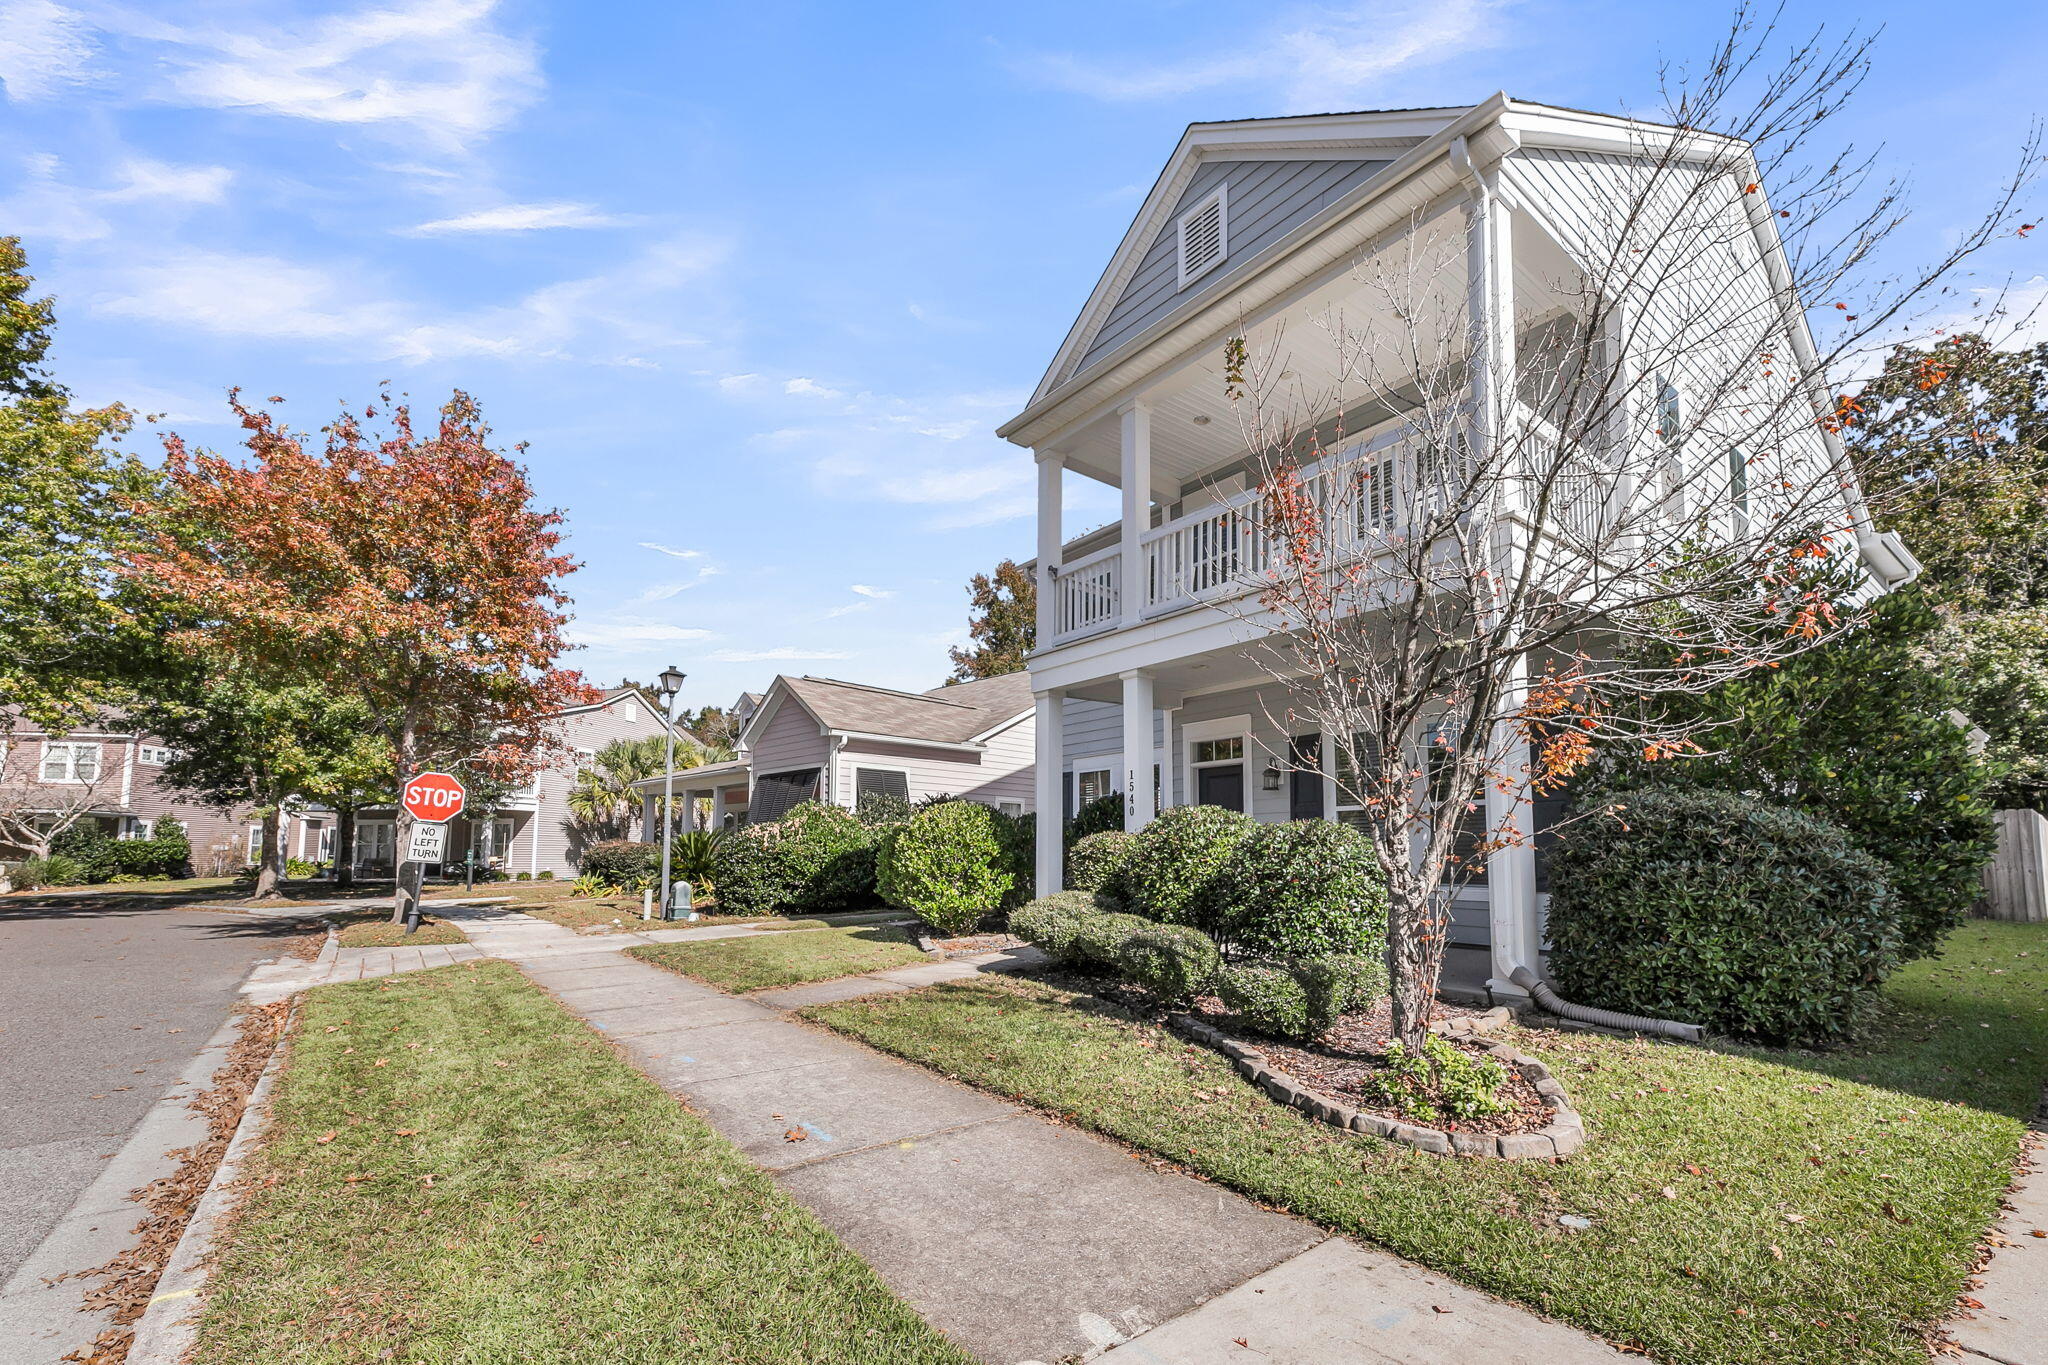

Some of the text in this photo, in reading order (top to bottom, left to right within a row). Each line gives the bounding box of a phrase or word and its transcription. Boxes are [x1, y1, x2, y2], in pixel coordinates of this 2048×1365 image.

[407, 786, 462, 808] STOP
[421, 827, 436, 837] NO
[414, 838, 439, 847] LEFT
[412, 849, 439, 859] TURN
